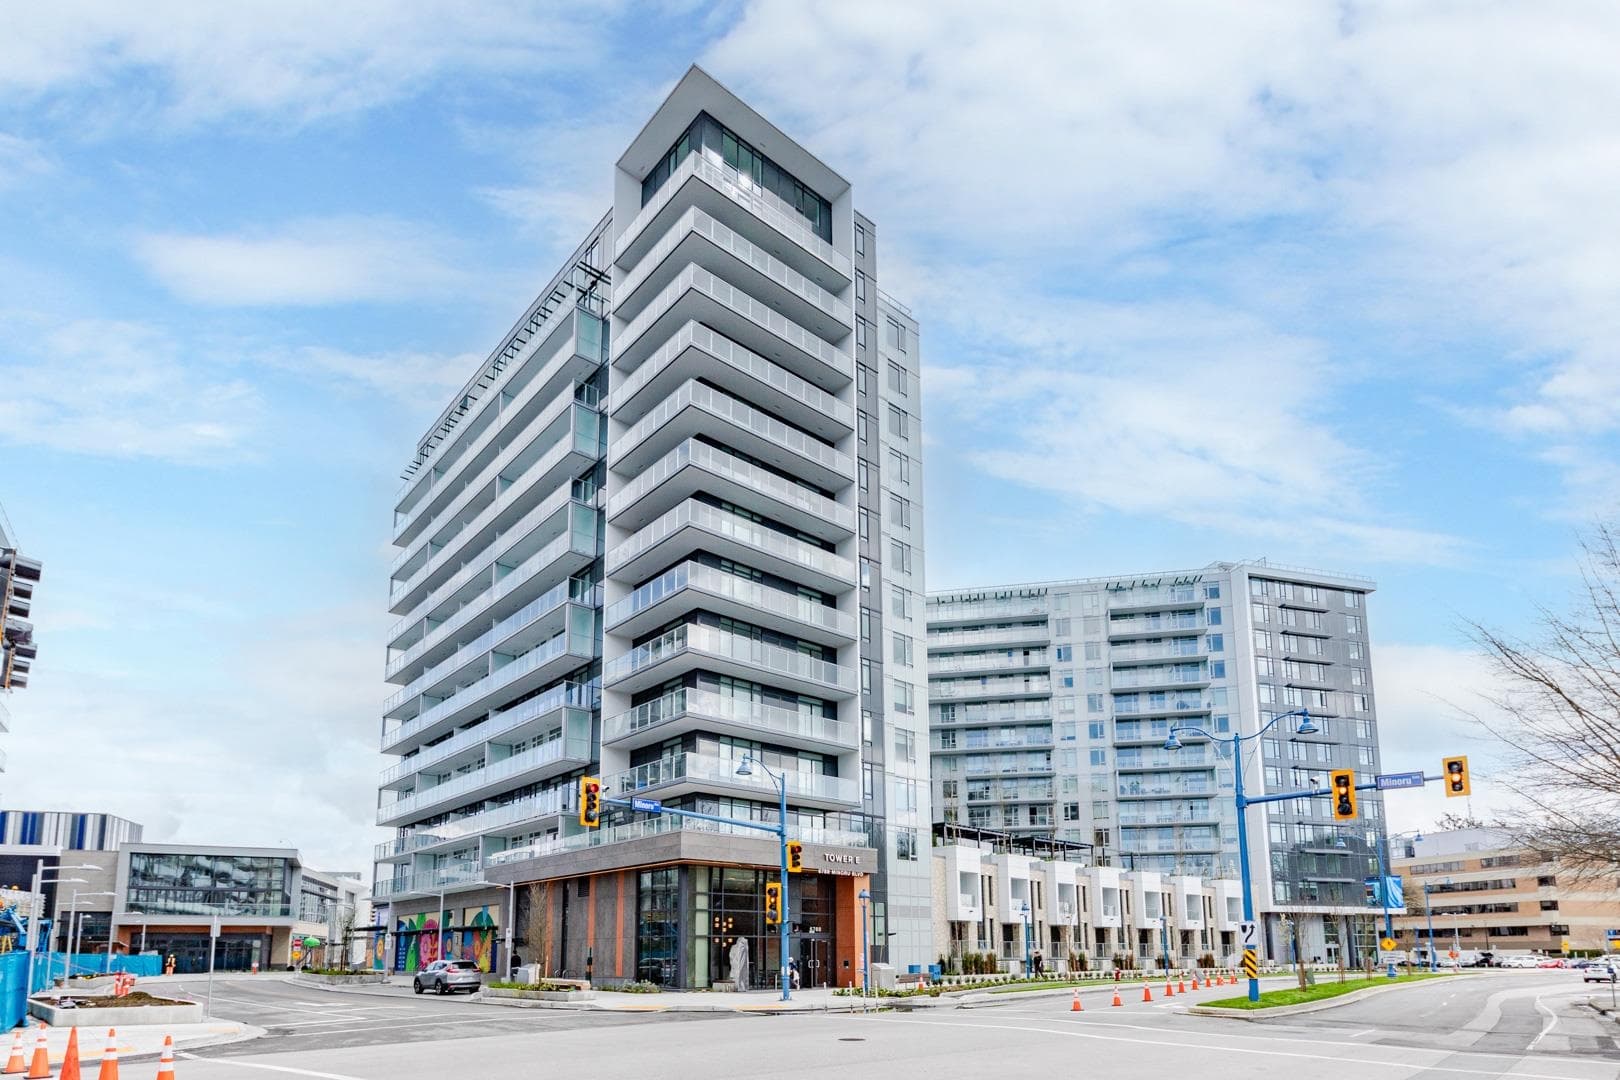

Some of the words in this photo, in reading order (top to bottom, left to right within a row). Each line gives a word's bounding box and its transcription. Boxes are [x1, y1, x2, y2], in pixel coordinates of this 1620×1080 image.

[1380, 778, 1412, 787] Minoru
[824, 853, 853, 863] TOWER
[855, 856, 861, 864] E
